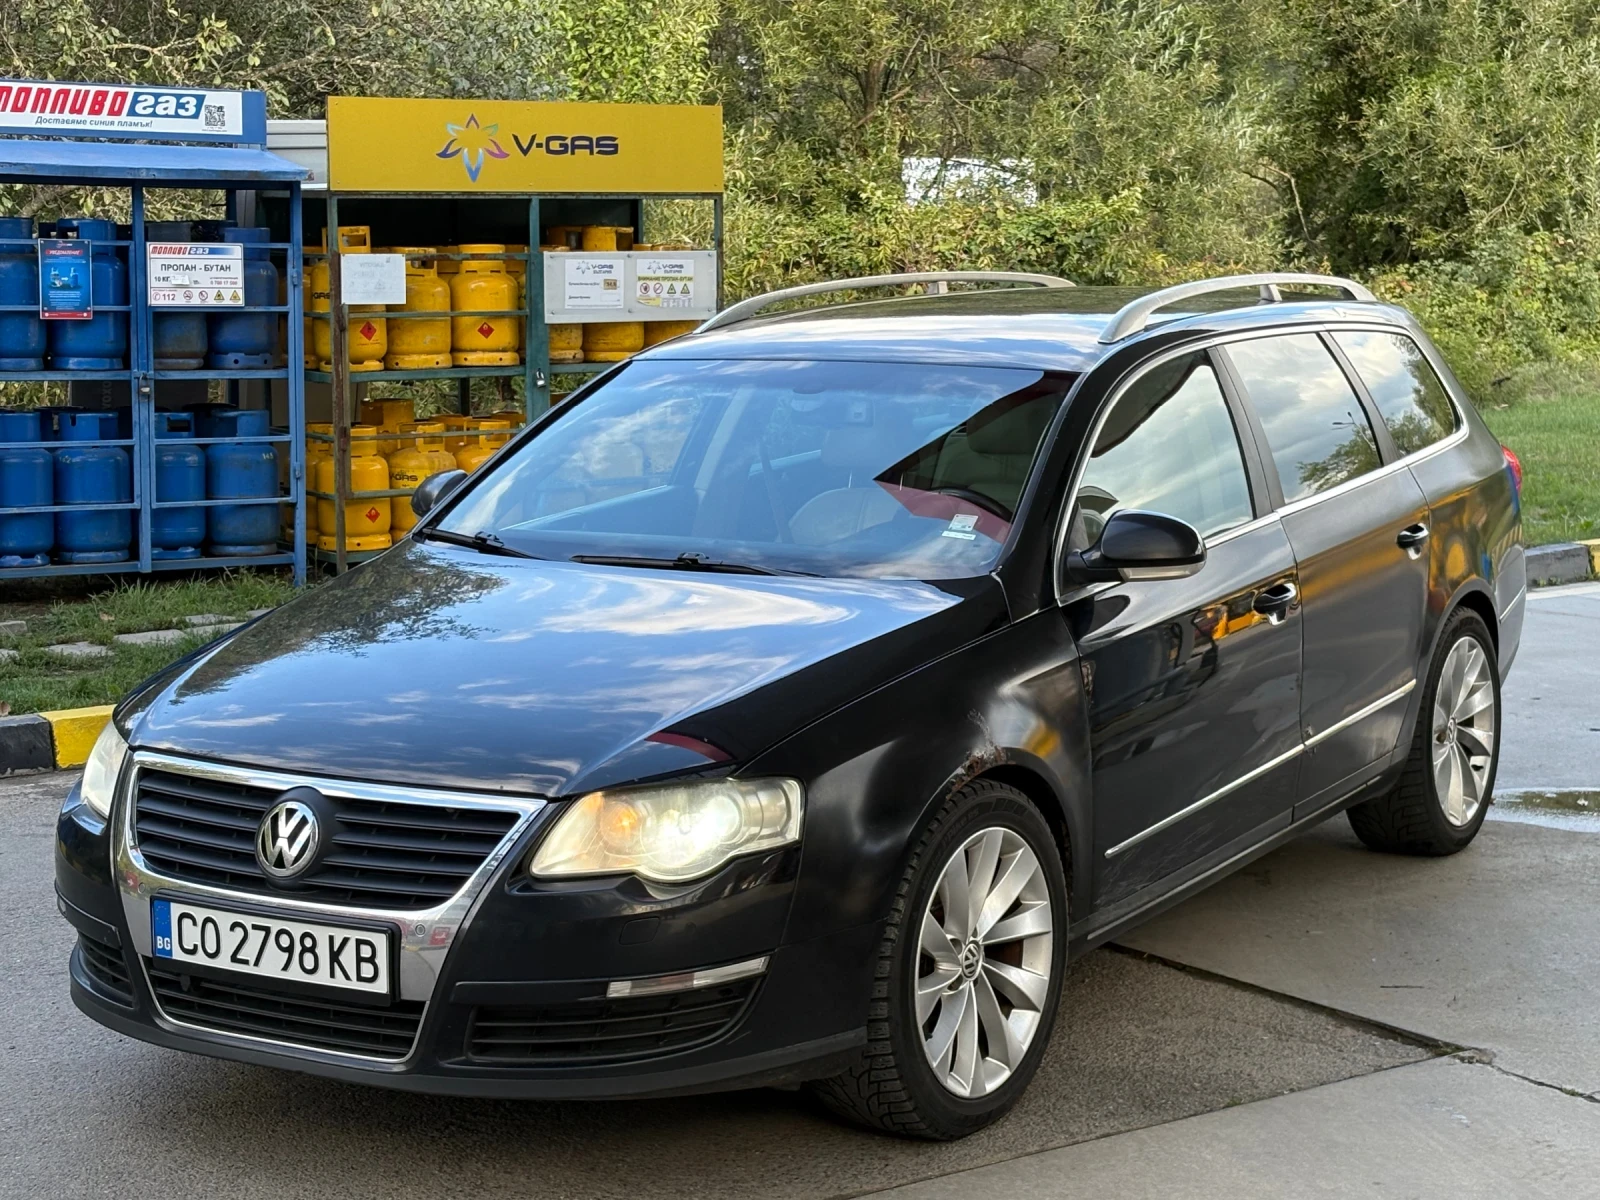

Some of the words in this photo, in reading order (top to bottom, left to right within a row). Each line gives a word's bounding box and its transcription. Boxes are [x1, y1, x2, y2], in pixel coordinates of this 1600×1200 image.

[35, 116, 88, 125] Доставяме
[89, 118, 115, 126] синия
[511, 133, 619, 157] V-GAS
[160, 263, 197, 272] ПРОПАН
[203, 264, 231, 272] БУТАН
[162, 293, 176, 301] 112
[156, 935, 171, 951] BG
[177, 911, 221, 960] CO
[229, 920, 320, 976] 2798
[328, 933, 380, 984] KB
